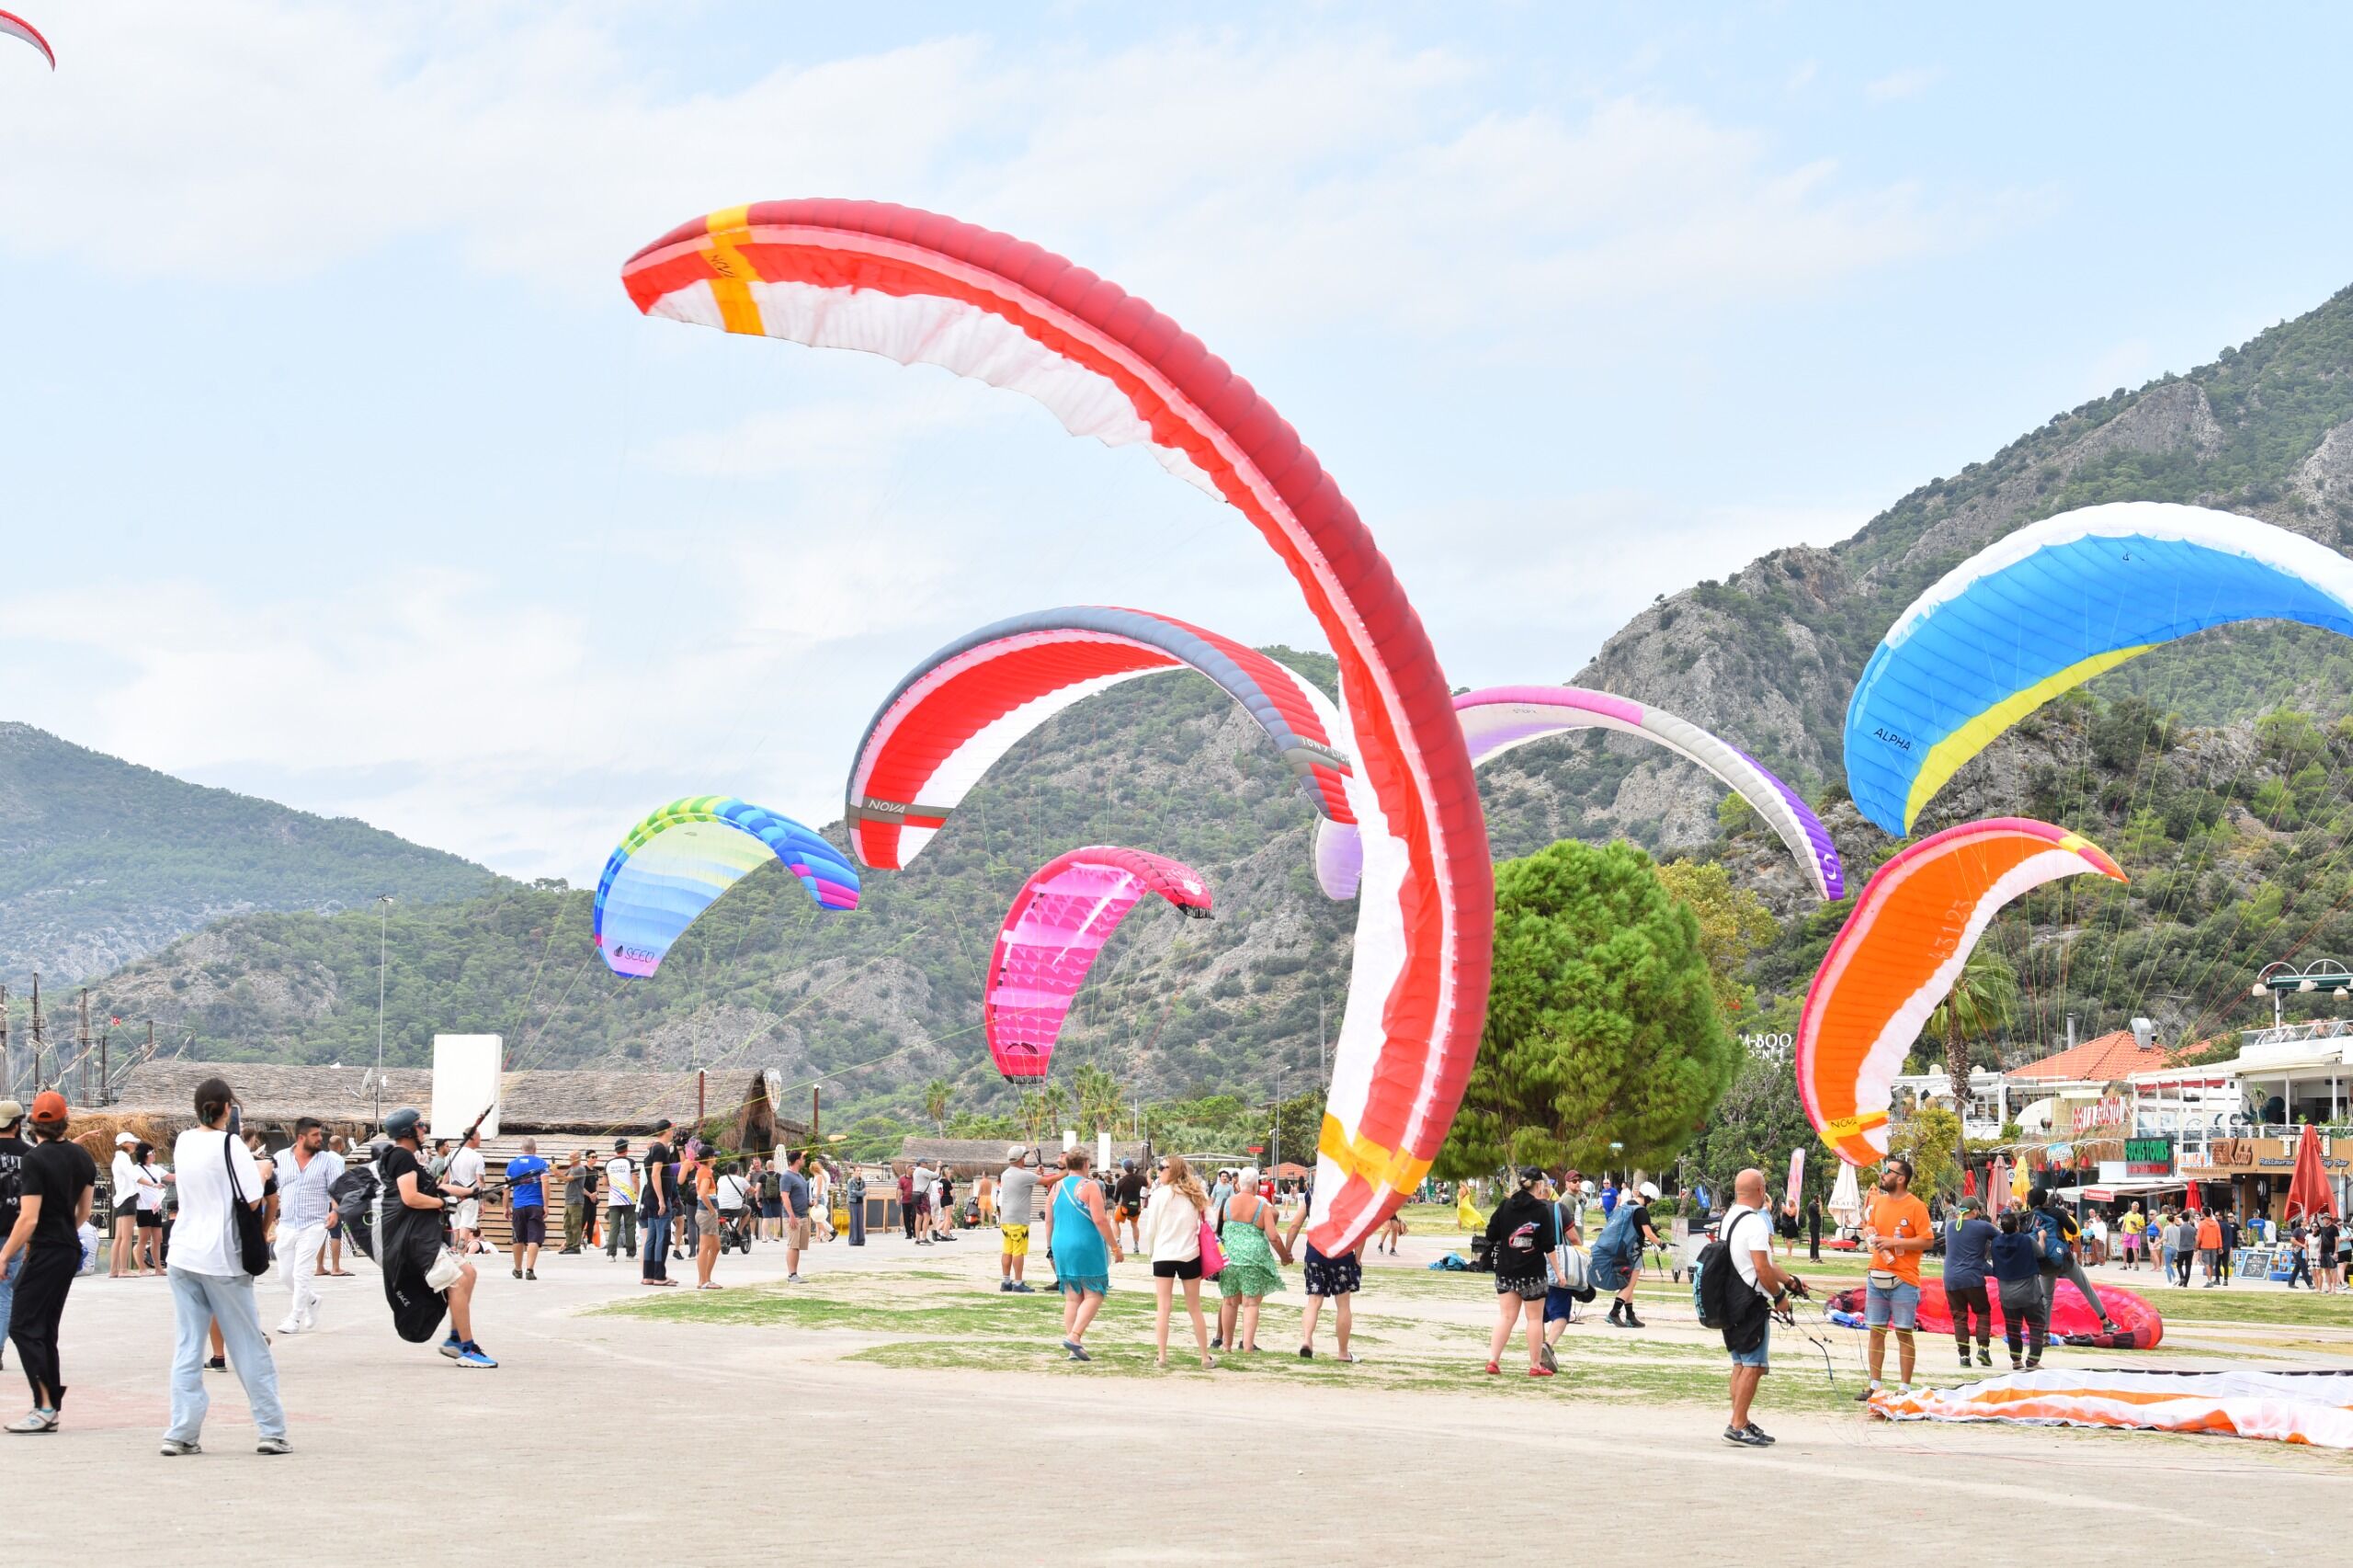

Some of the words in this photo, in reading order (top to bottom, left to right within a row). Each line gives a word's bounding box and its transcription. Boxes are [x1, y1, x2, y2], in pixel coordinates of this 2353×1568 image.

[1873, 728, 1911, 751] ALPHA
[868, 799, 906, 814] NOVA
[625, 947, 655, 964] SEED
[2125, 1140, 2145, 1161] FOCUS
[2145, 1140, 2169, 1161] TOURS
[2259, 1158, 2295, 1166] Restauran
[2335, 1159, 2348, 1167] Bar
[395, 1290, 412, 1308] RACE
